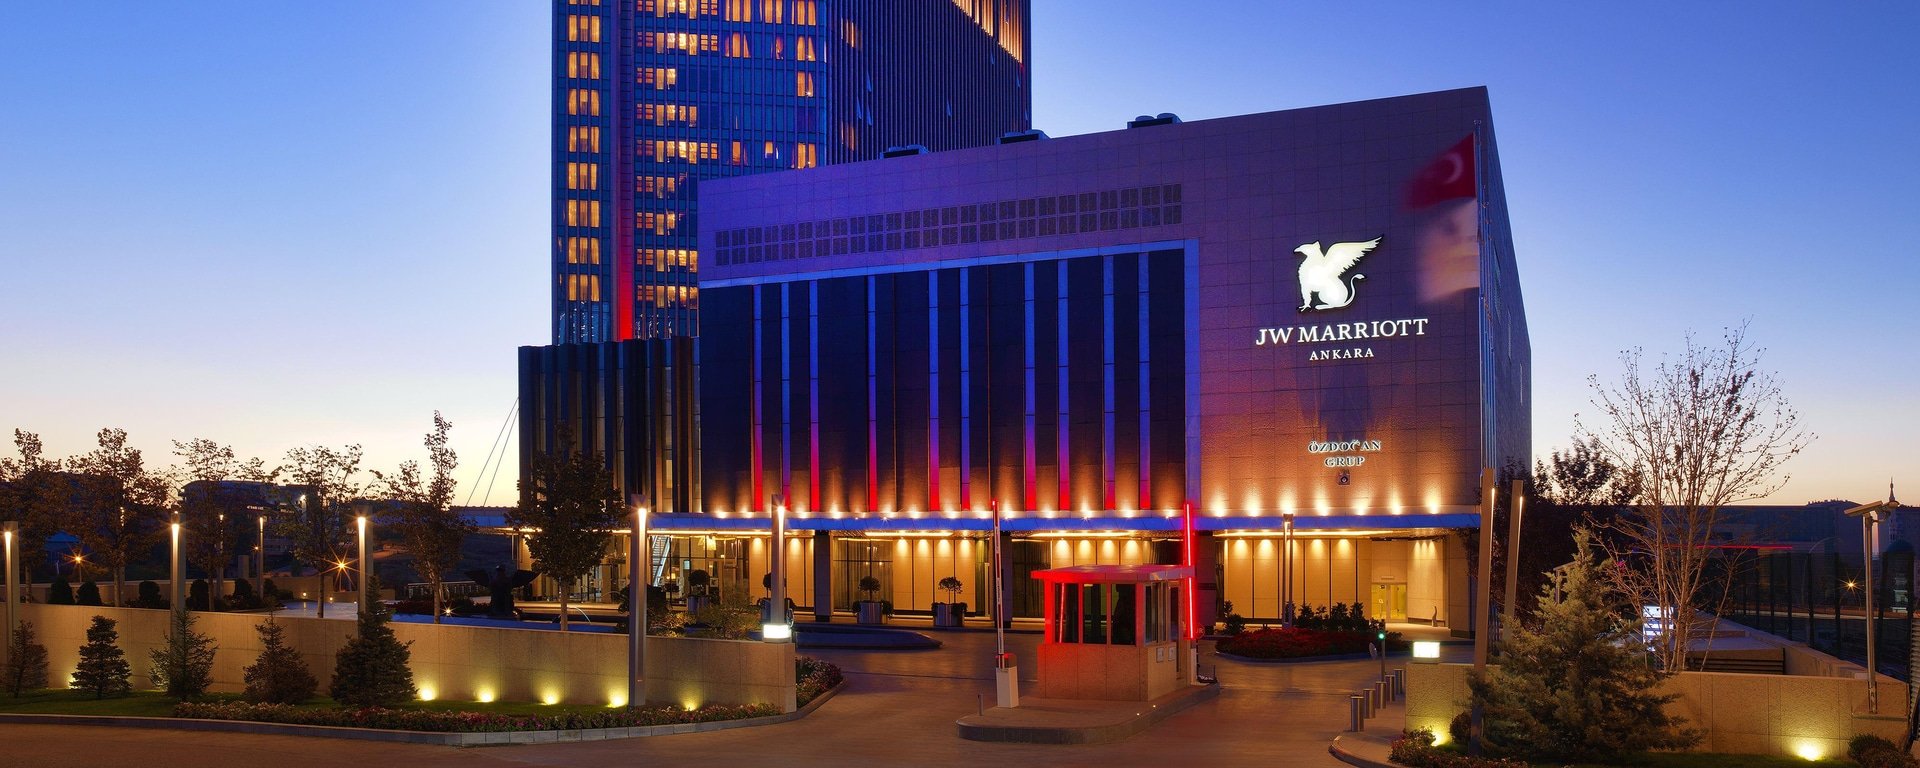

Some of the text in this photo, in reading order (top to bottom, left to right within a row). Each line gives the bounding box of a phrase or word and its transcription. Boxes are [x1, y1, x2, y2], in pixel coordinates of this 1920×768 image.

[1256, 318, 1428, 345] JW MARRIOTT
[1309, 348, 1374, 361] ANKARA
[1324, 456, 1365, 467] GRUP
